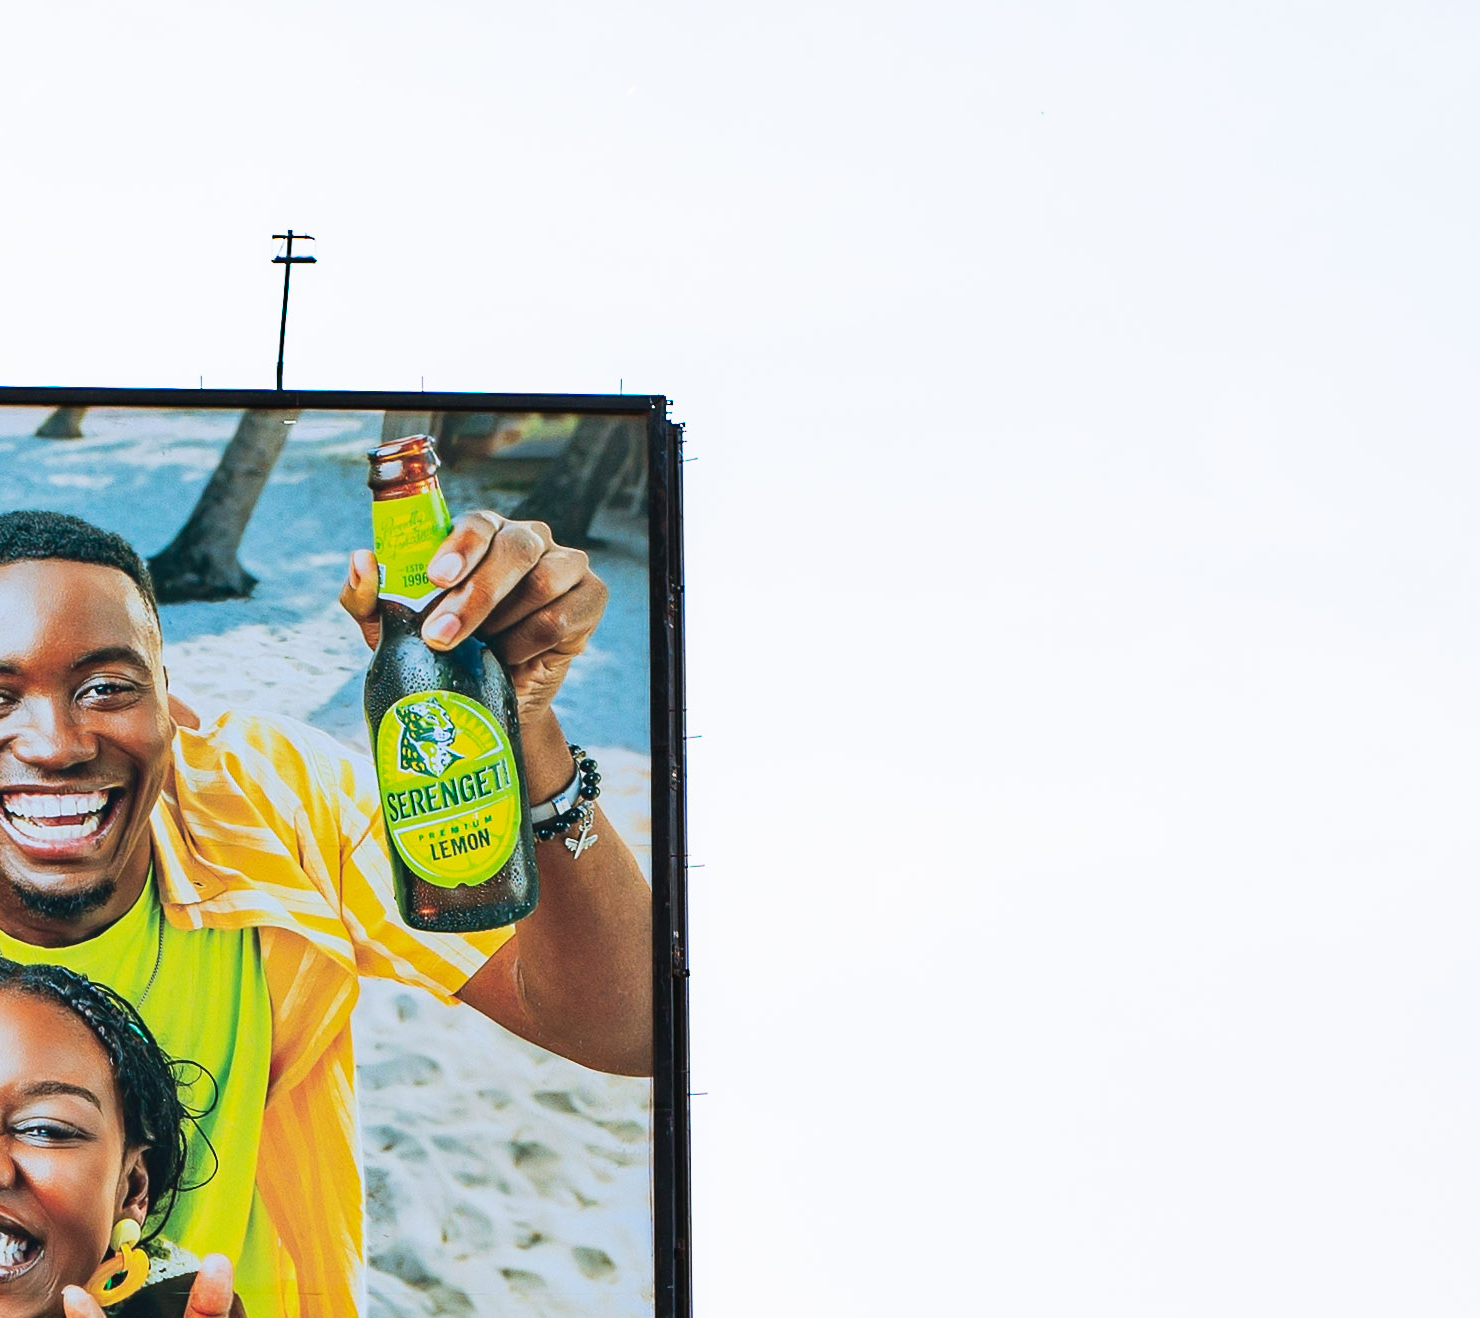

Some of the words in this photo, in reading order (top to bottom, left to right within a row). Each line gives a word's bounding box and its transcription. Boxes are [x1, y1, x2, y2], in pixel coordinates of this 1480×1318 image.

[402, 573, 429, 588] 1996
[386, 758, 512, 823] SERENGETI
[418, 814, 493, 842] PREMIUM
[429, 828, 491, 861] LEMON
